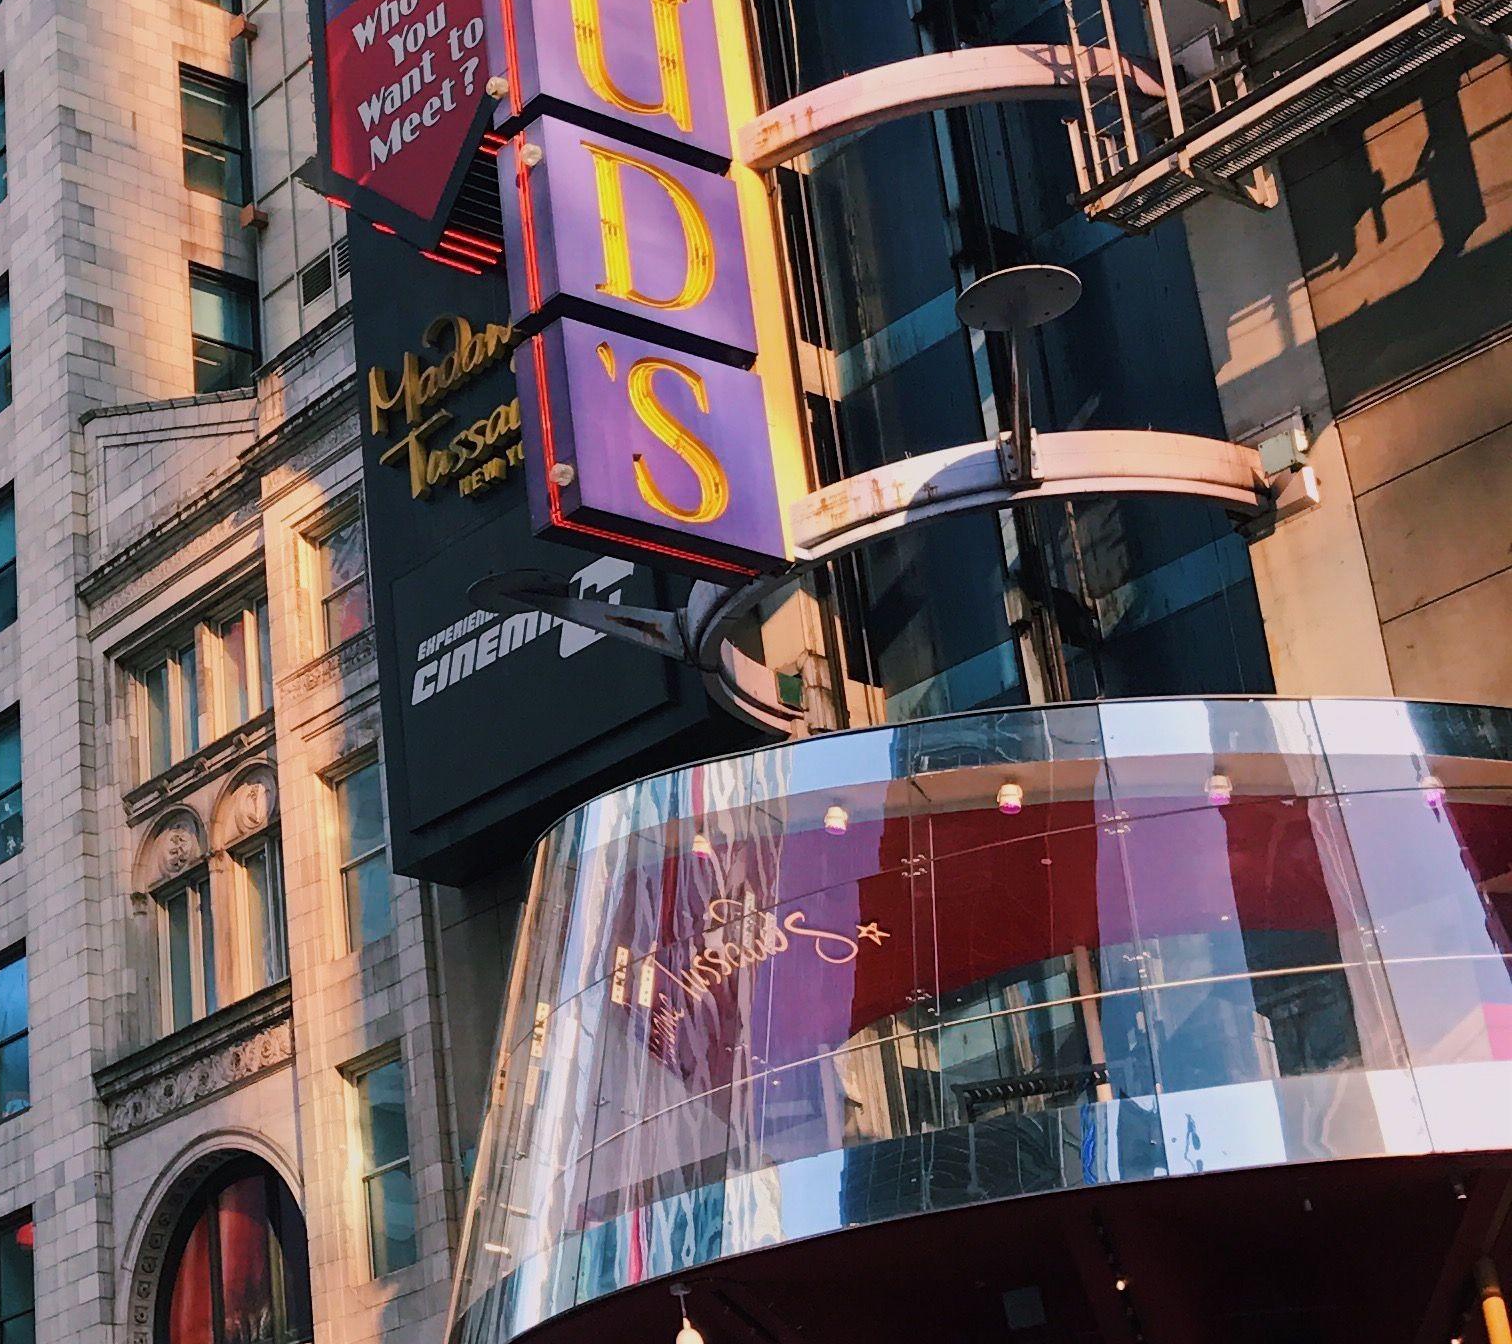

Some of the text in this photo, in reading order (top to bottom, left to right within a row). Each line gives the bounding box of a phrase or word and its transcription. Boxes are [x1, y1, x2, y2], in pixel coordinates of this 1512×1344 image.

[356, 15, 485, 135] Want to
[386, 1, 448, 69] You
[369, 312, 522, 437] Madam
[458, 455, 508, 500] NEW
